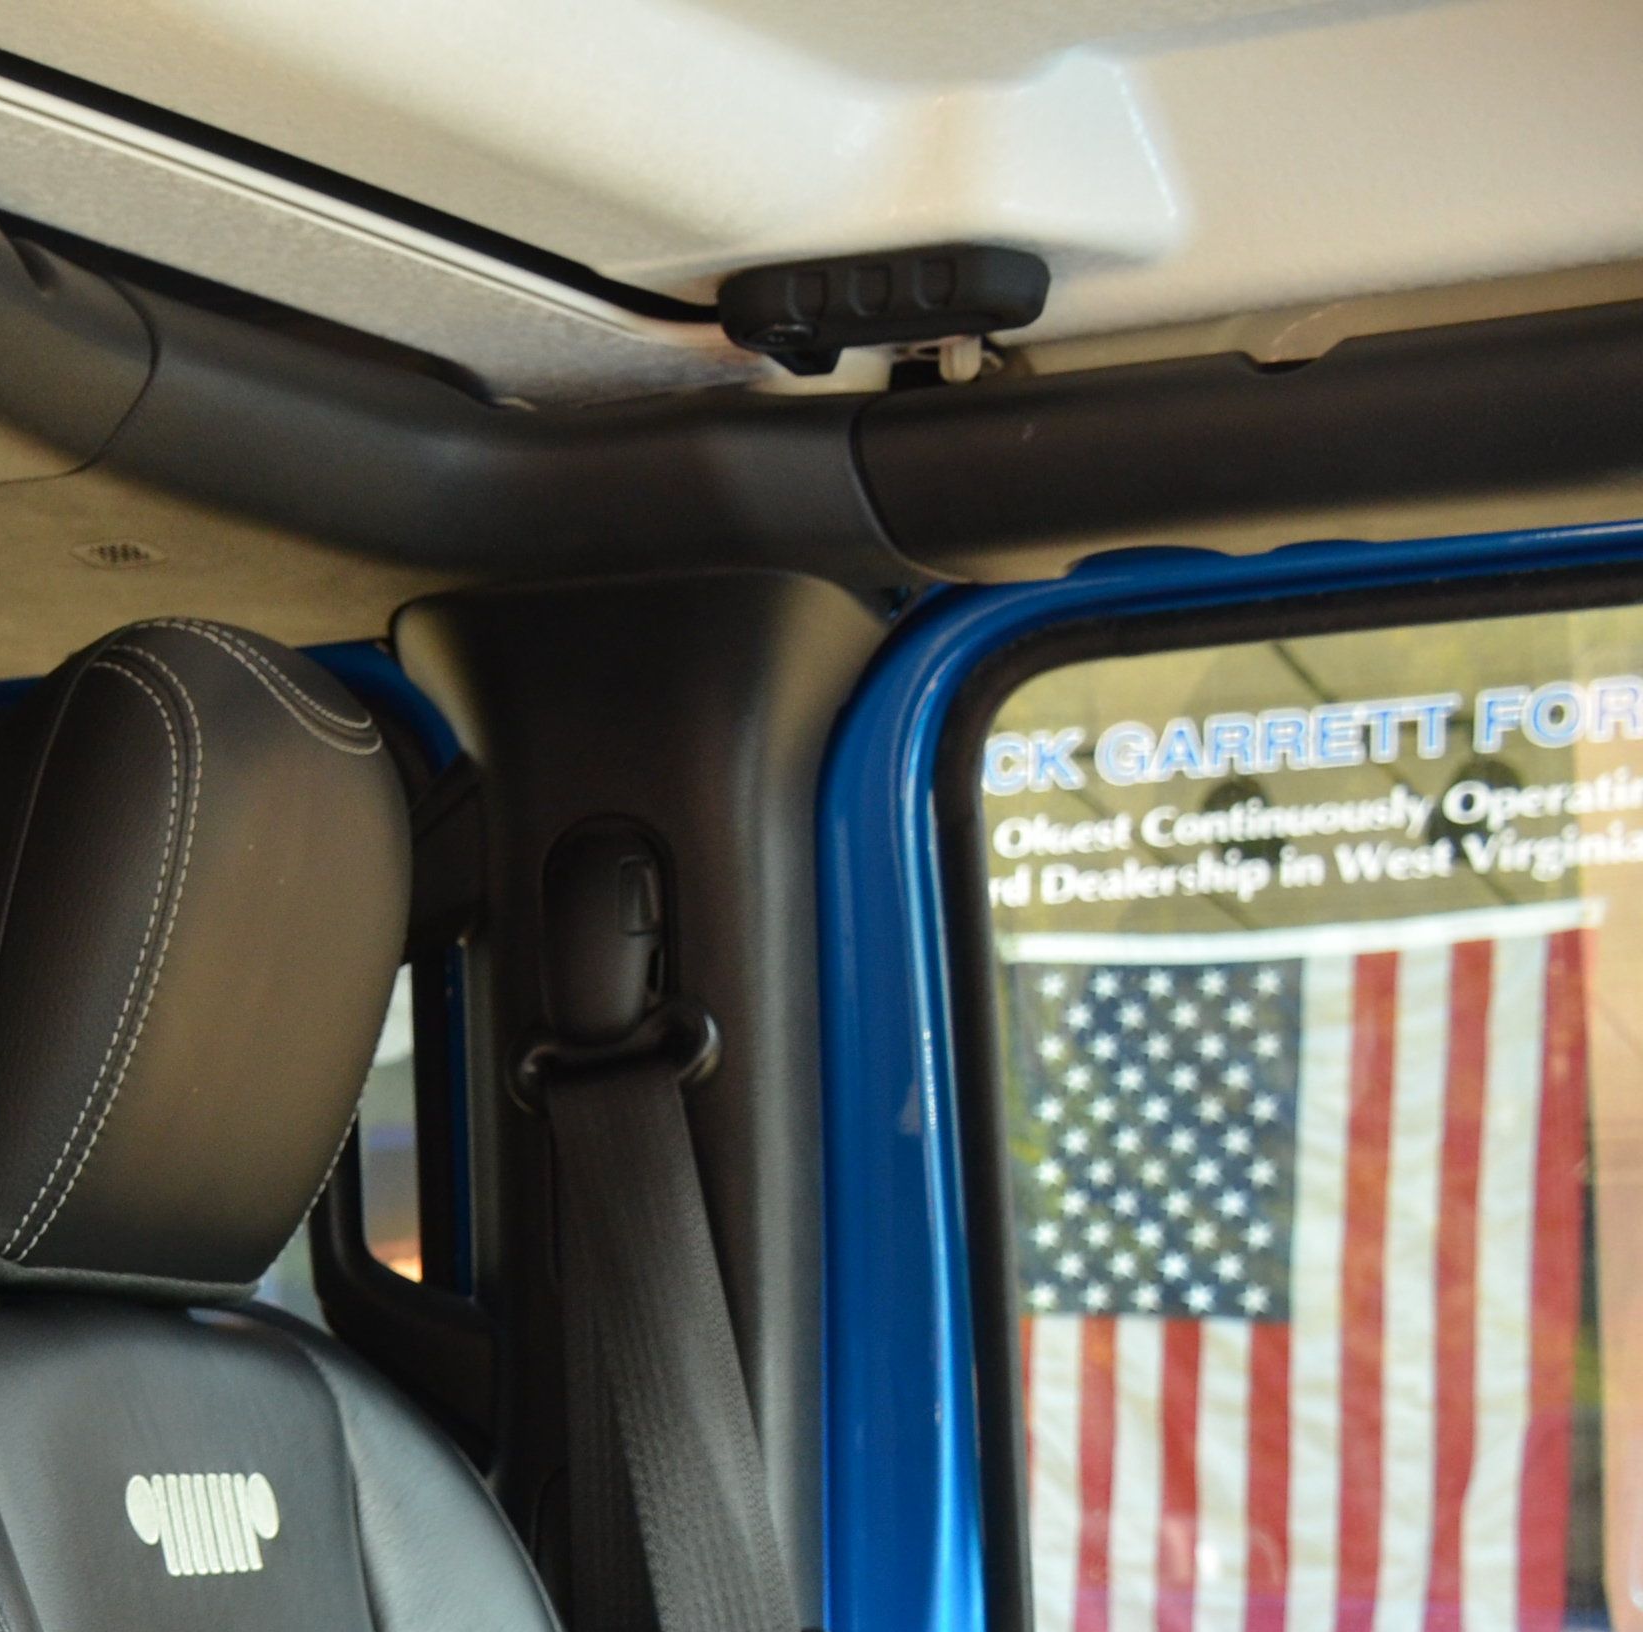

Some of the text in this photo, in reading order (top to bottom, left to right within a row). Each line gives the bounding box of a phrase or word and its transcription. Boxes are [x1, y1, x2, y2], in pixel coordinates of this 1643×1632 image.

[1094, 692, 1463, 787] GARRETT
[1473, 674, 1643, 754] FOR
[1140, 783, 1437, 848] Continuously
[1040, 846, 1271, 904] Dealership
[1279, 844, 1327, 888] in
[1333, 836, 1454, 885] West
